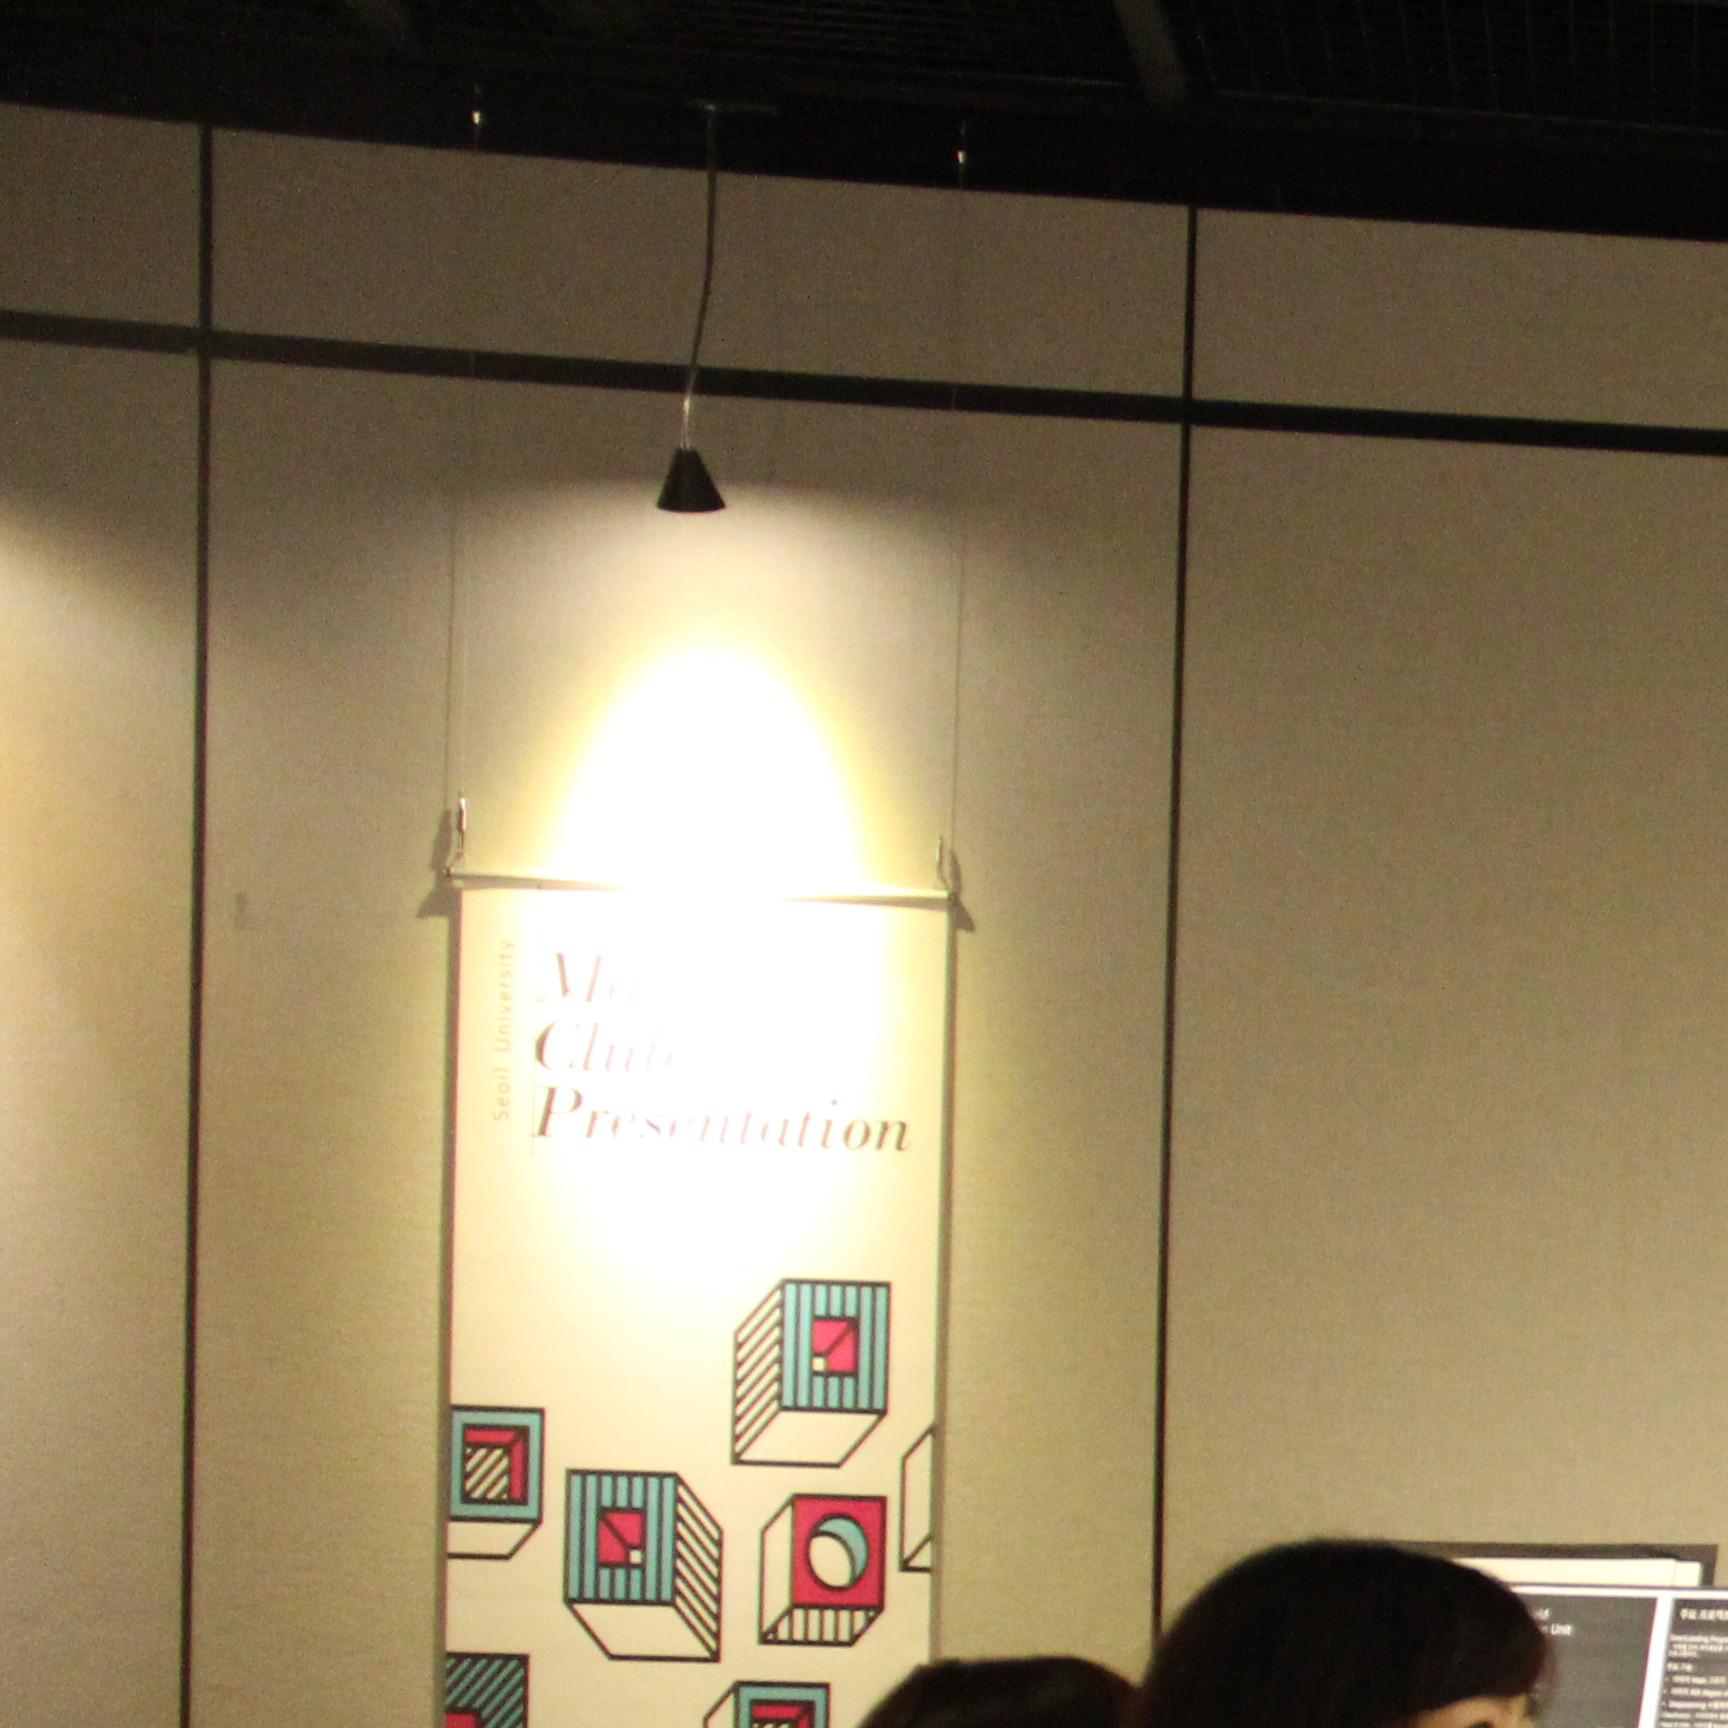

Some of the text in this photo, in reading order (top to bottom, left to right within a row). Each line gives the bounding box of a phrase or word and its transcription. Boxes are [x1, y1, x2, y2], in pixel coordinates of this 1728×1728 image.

[492, 938, 517, 1121] Seoil University
[529, 1084, 913, 1153] Presentation
[1550, 1623, 1573, 1635] Unit
